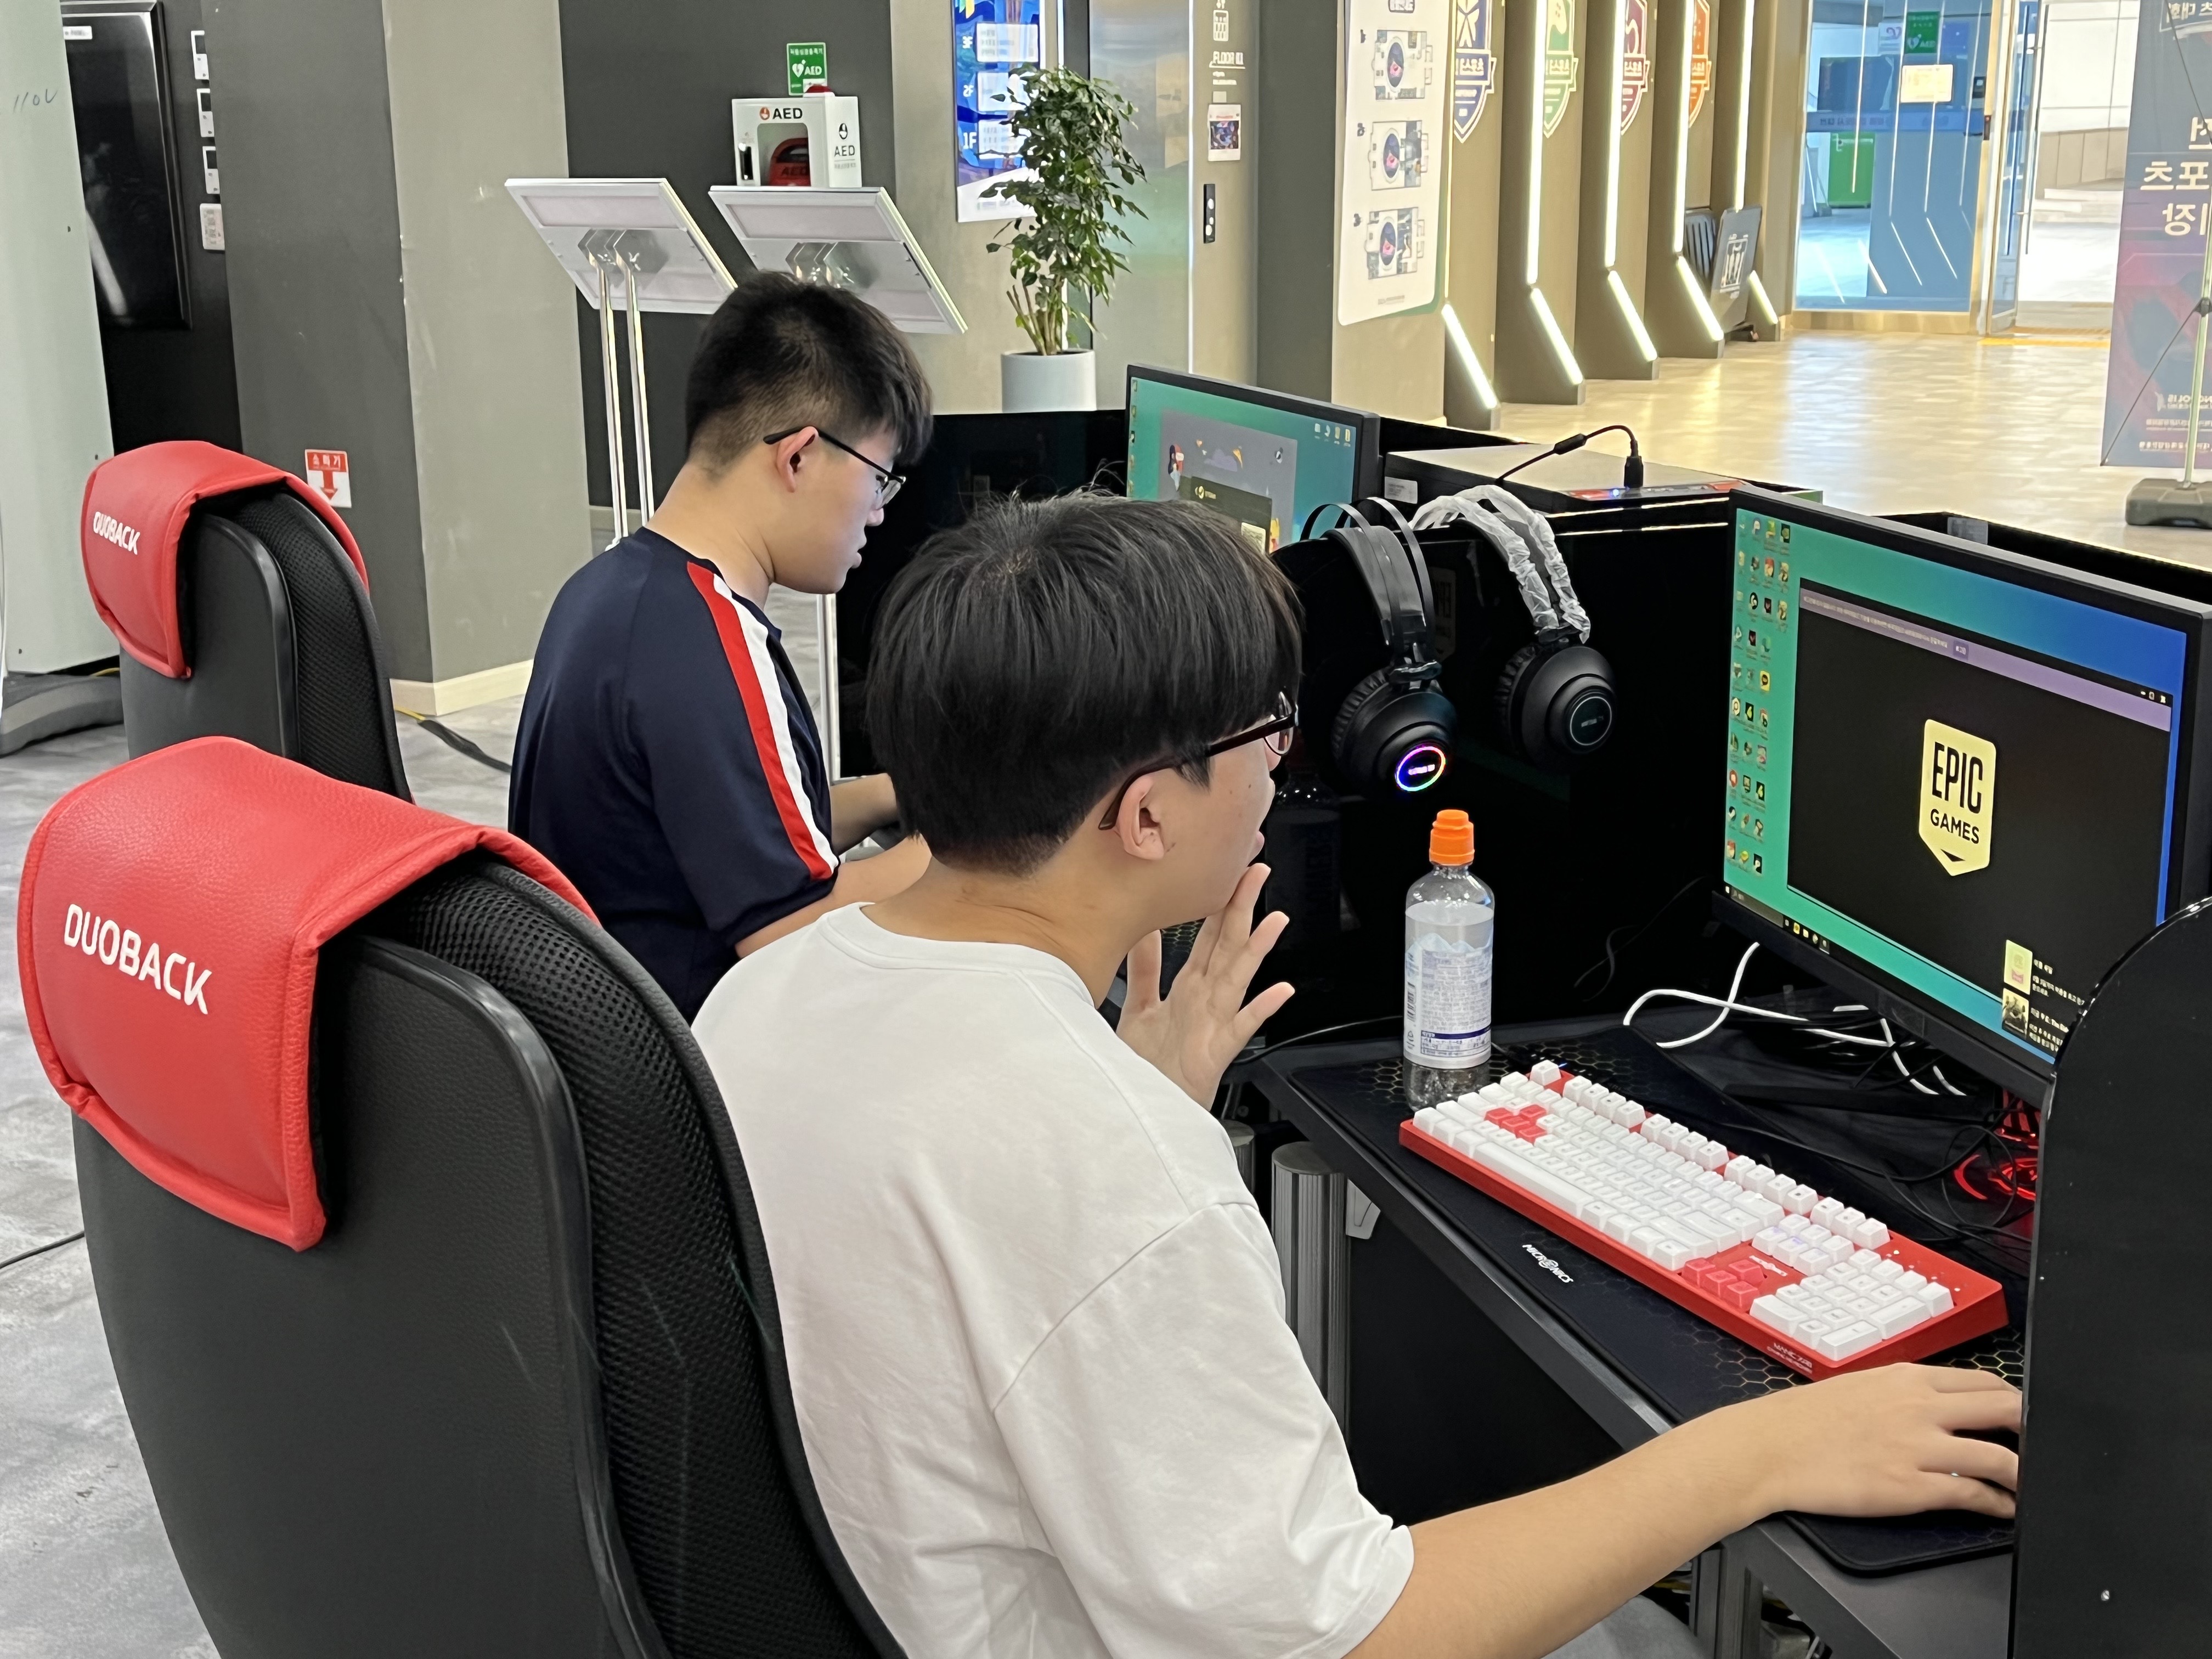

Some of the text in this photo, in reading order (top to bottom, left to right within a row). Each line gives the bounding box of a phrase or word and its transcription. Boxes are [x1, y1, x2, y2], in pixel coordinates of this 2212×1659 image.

[804, 66, 822, 76] AED
[772, 108, 803, 120] AED
[834, 145, 855, 157] AED
[963, 132, 977, 150] 1F
[93, 511, 140, 555] DUOBACK
[1932, 741, 1983, 814] EPIC
[1930, 809, 1979, 844] GAMES
[64, 904, 212, 1015] DUOBACK
